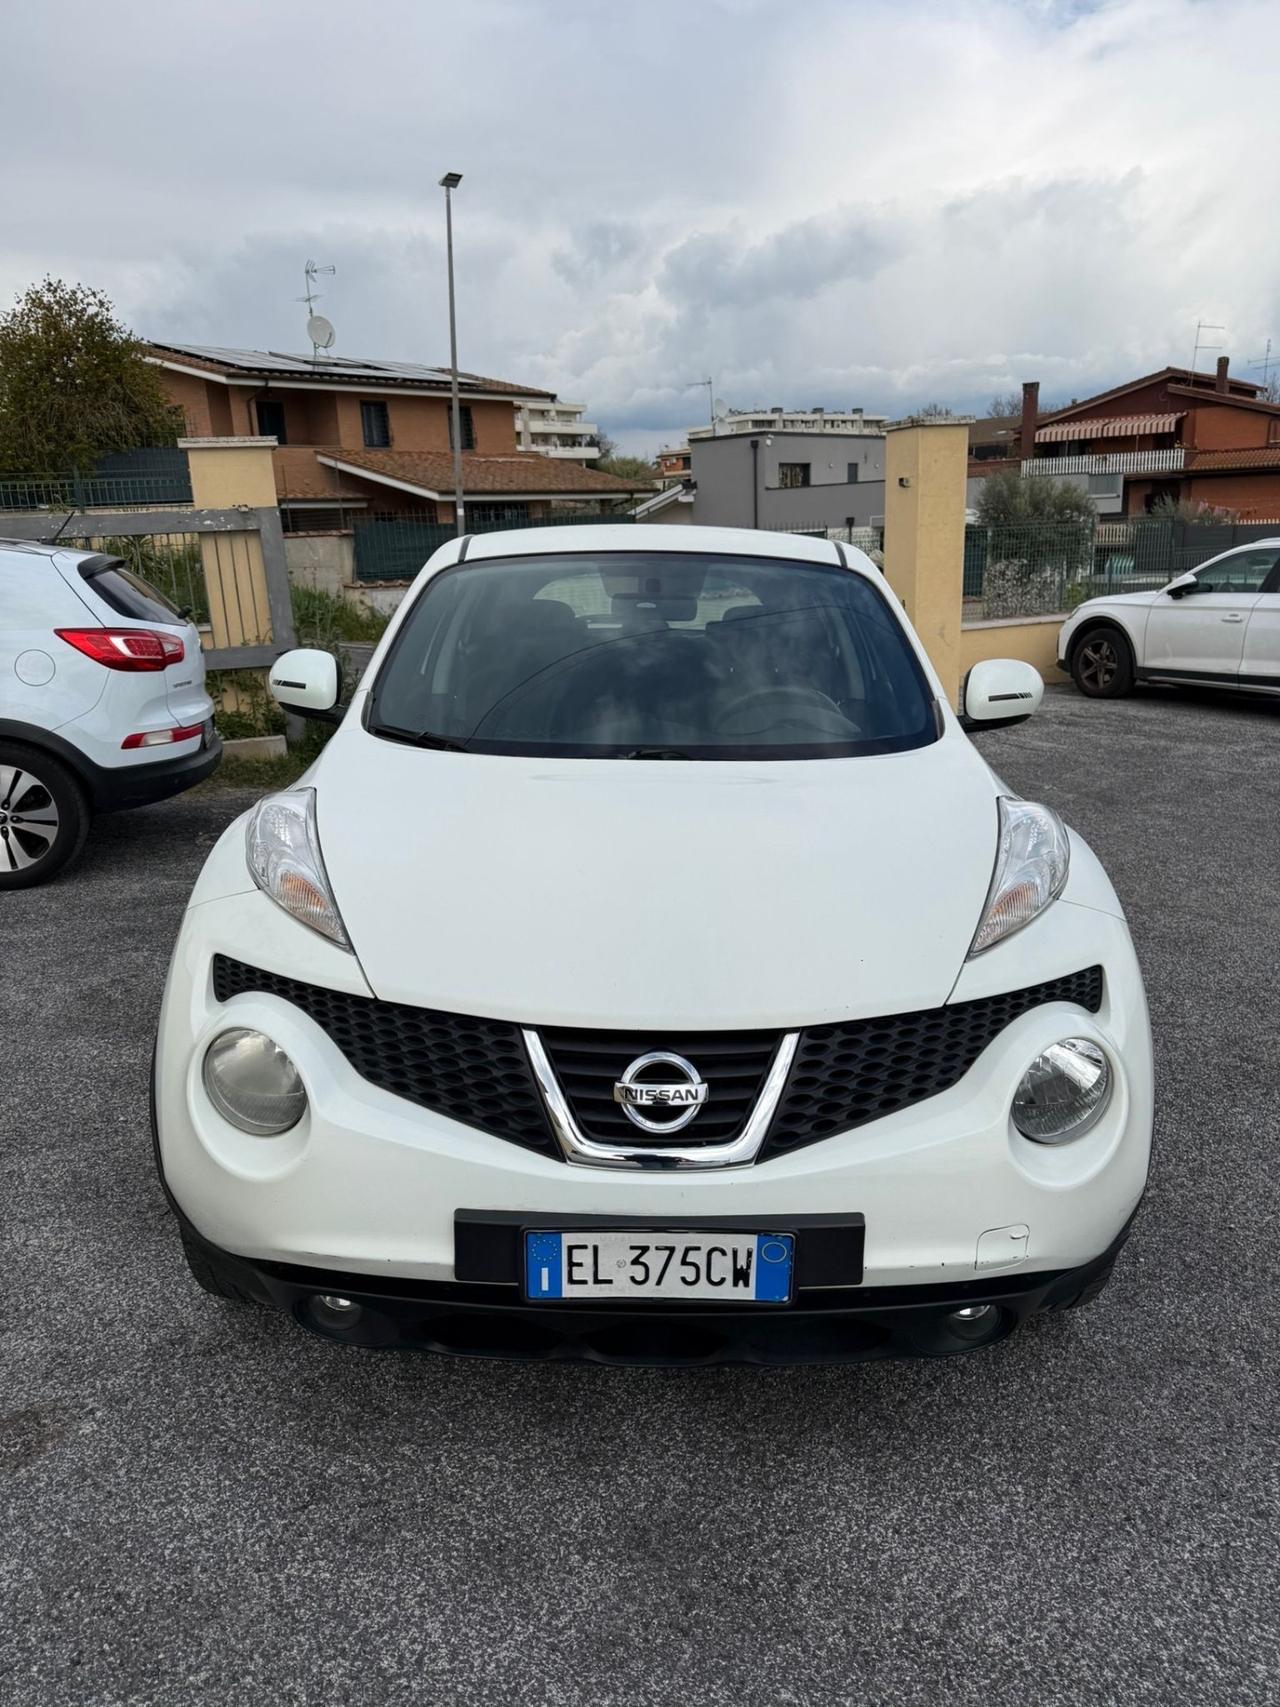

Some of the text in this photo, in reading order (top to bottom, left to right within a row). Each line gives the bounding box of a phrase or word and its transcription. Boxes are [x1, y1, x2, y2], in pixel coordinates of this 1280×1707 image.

[624, 1088, 699, 1101] NISSAN
[566, 1244, 754, 1288] EL 375CW
